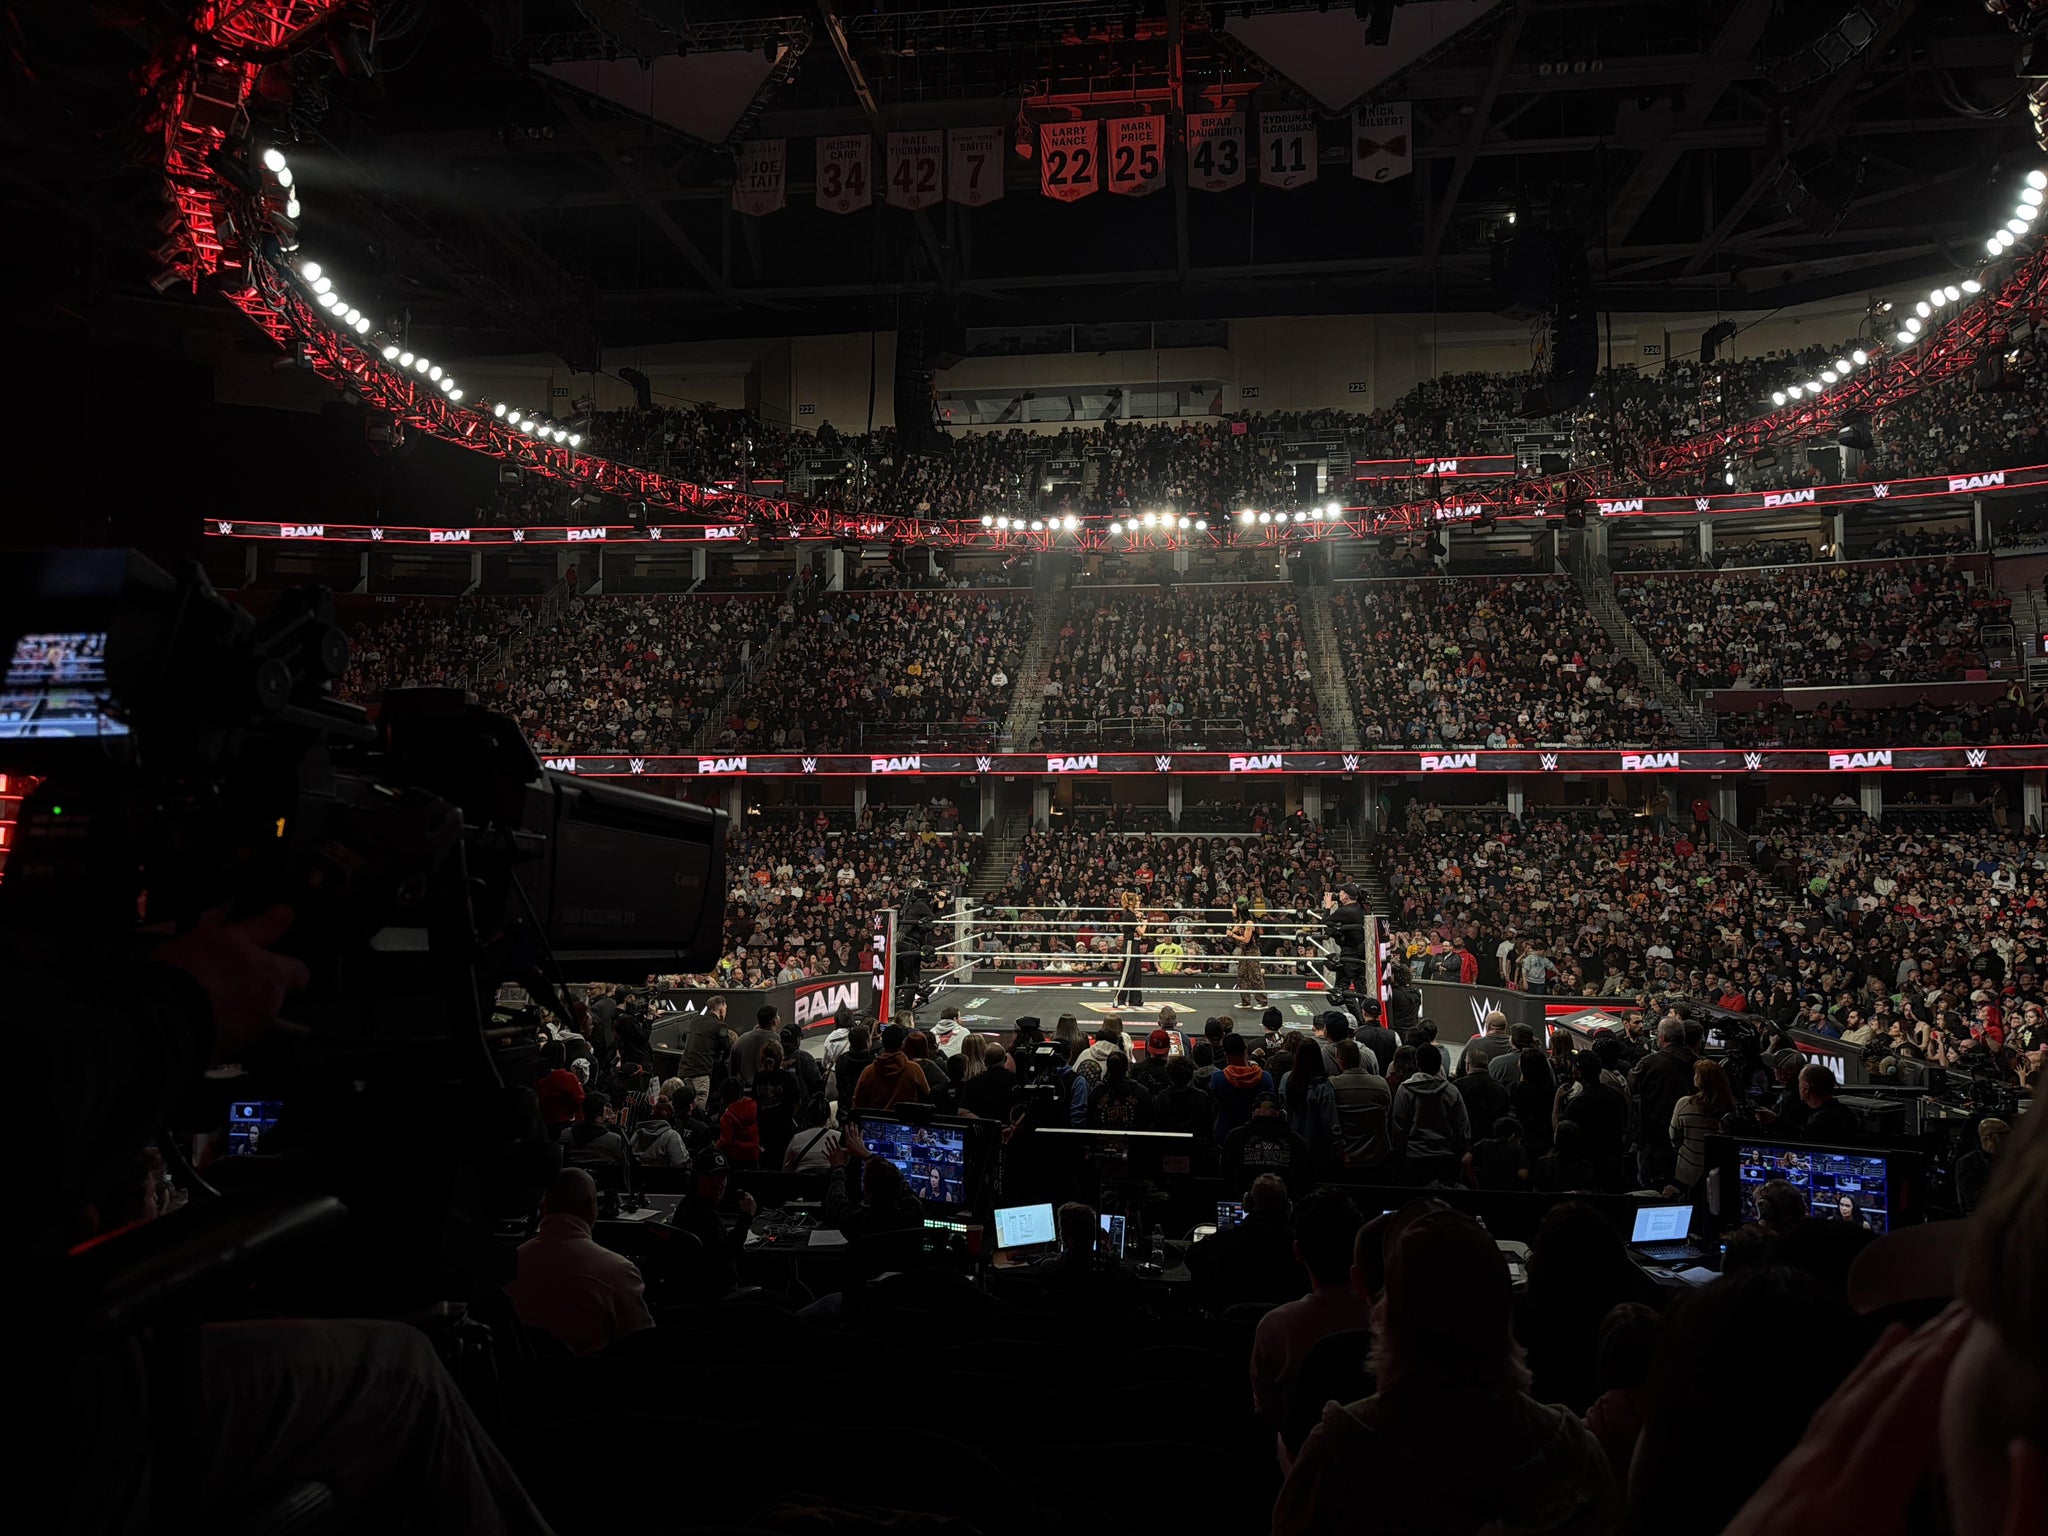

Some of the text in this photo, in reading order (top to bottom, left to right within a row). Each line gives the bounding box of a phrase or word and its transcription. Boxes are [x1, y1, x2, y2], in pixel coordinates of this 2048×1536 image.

[1368, 106, 1394, 116] NICK
[1201, 117, 1231, 127] BRAD
[1263, 113, 1313, 124] ZYDRUNAS
[1358, 116, 1404, 127] GILBERT
[1052, 126, 1087, 137] LARRY
[1121, 121, 1152, 132] MARK
[1262, 123, 1315, 134] ILGAUSKAS
[1121, 131, 1153, 142] PRICE
[1189, 127, 1243, 138] DAUGHERTY
[826, 141, 861, 150] AUSTIN
[902, 135, 928, 145] NATE
[1052, 136, 1087, 147] NANCE
[960, 142, 992, 152] SMITH
[830, 151, 857, 160] CARR
[1194, 140, 1239, 177] 43
[1270, 137, 1306, 172] 11
[752, 160, 778, 174] JOE
[1048, 148, 1091, 185] 22
[1115, 144, 1159, 182] 25
[893, 158, 936, 193] 42
[967, 155, 985, 189] 7
[750, 174, 781, 188] TAIT
[823, 161, 864, 198] 34
[1644, 346, 1661, 354] 226
[553, 388, 568, 396] 221
[1242, 388, 1259, 397] 224
[1349, 384, 1366, 392] 225
[800, 405, 814, 413] 222
[1598, 500, 1643, 515] RAW
[1764, 490, 1815, 507] RAW
[1949, 472, 2005, 491] RAW
[281, 525, 324, 537] RAW
[430, 530, 470, 542] RAW
[568, 528, 607, 541] RAW
[545, 758, 576, 772] AW
[699, 757, 747, 773] RAW
[871, 756, 920, 773] RAW
[1047, 755, 1098, 772] RAW
[1229, 754, 1282, 772] RAW
[1421, 753, 1476, 771] RAW
[1622, 752, 1679, 770] RAW
[1829, 751, 1892, 770] RAW
[794, 982, 859, 1026] RAW
[1800, 1053, 1846, 1086] AW
